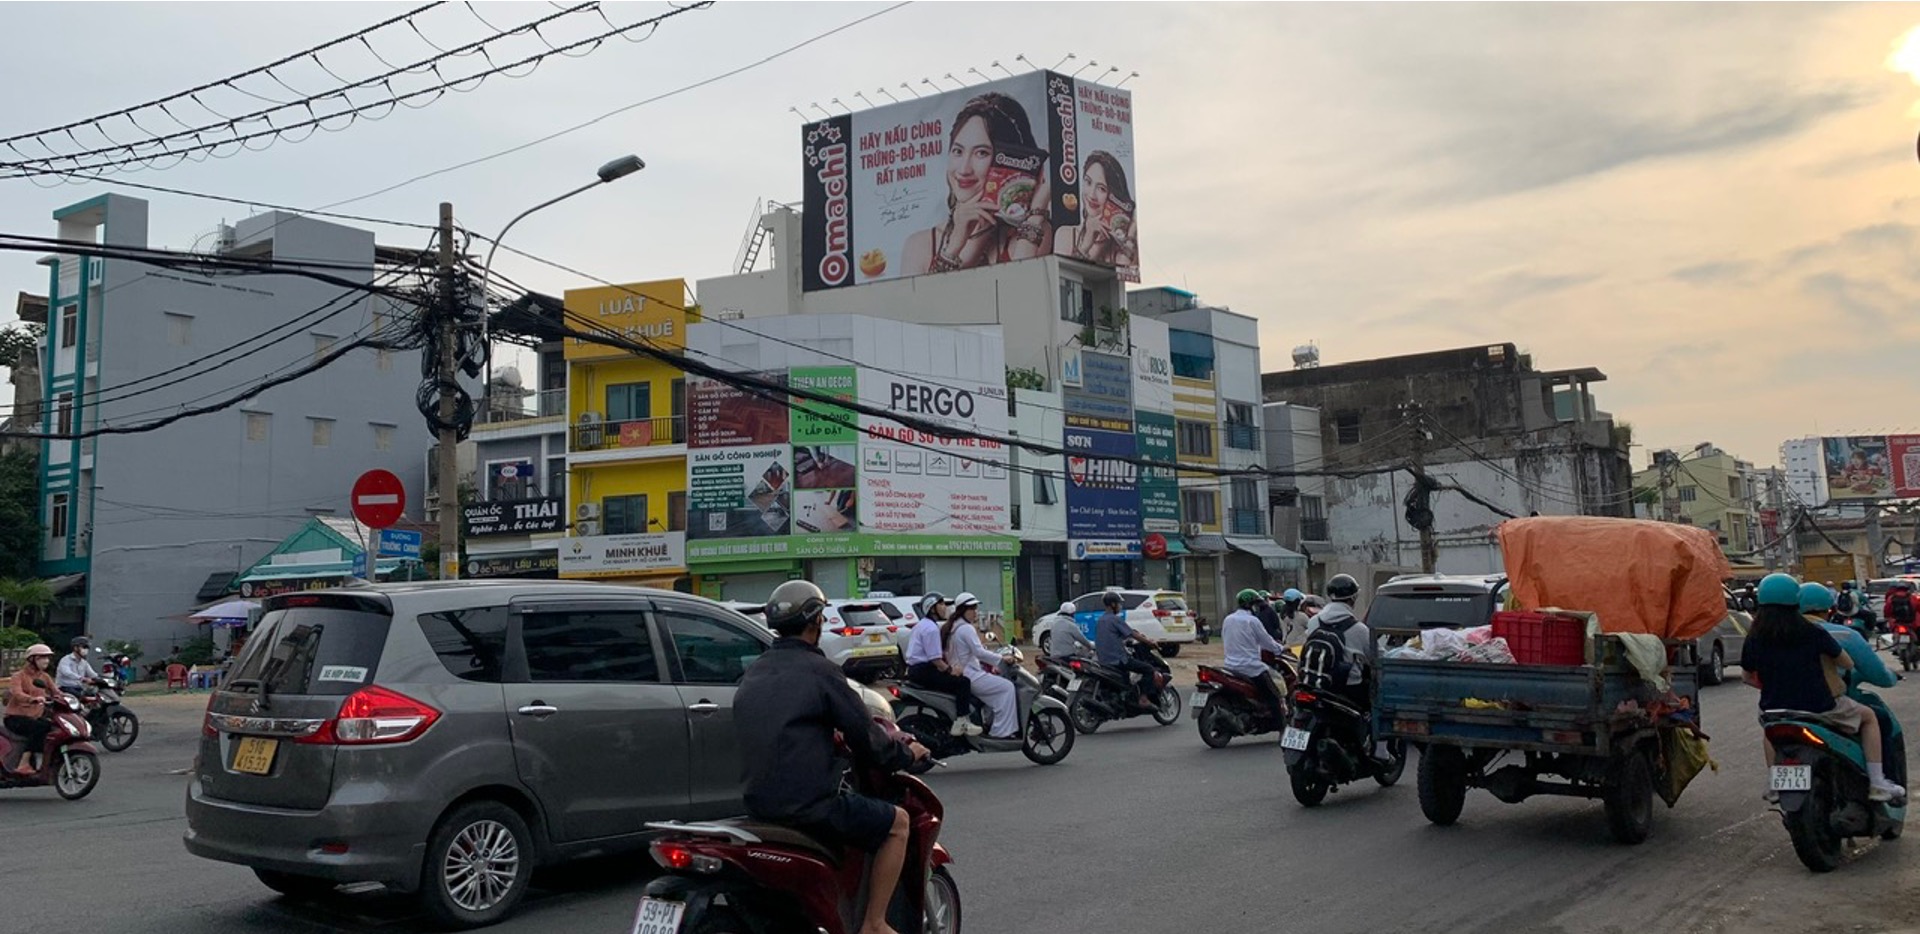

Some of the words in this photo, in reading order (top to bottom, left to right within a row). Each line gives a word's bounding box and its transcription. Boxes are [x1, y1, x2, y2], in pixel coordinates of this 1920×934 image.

[860, 132, 881, 151] HÃY
[885, 124, 907, 145] NẤU
[912, 120, 942, 140] CÙNG
[1058, 94, 1077, 185] Omachi
[860, 140, 942, 170] TRỨNG-BÒ-RAU
[996, 153, 1033, 171] Omachi
[877, 167, 893, 185] RẤT
[820, 142, 849, 286] Omachi
[600, 295, 647, 318] LUẬT
[891, 382, 974, 418] PERGO
[727, 451, 751, 460] CÔNG
[1088, 459, 1137, 483] HINO
[490, 504, 502, 515] ỐC
[514, 500, 558, 519] THÁI
[526, 520, 539, 530] Các
[382, 540, 402, 551] TRƯỜNG
[391, 533, 412, 541] ĐƯỜNG
[606, 548, 636, 559] MINH
[637, 543, 668, 557] KHUÊ
